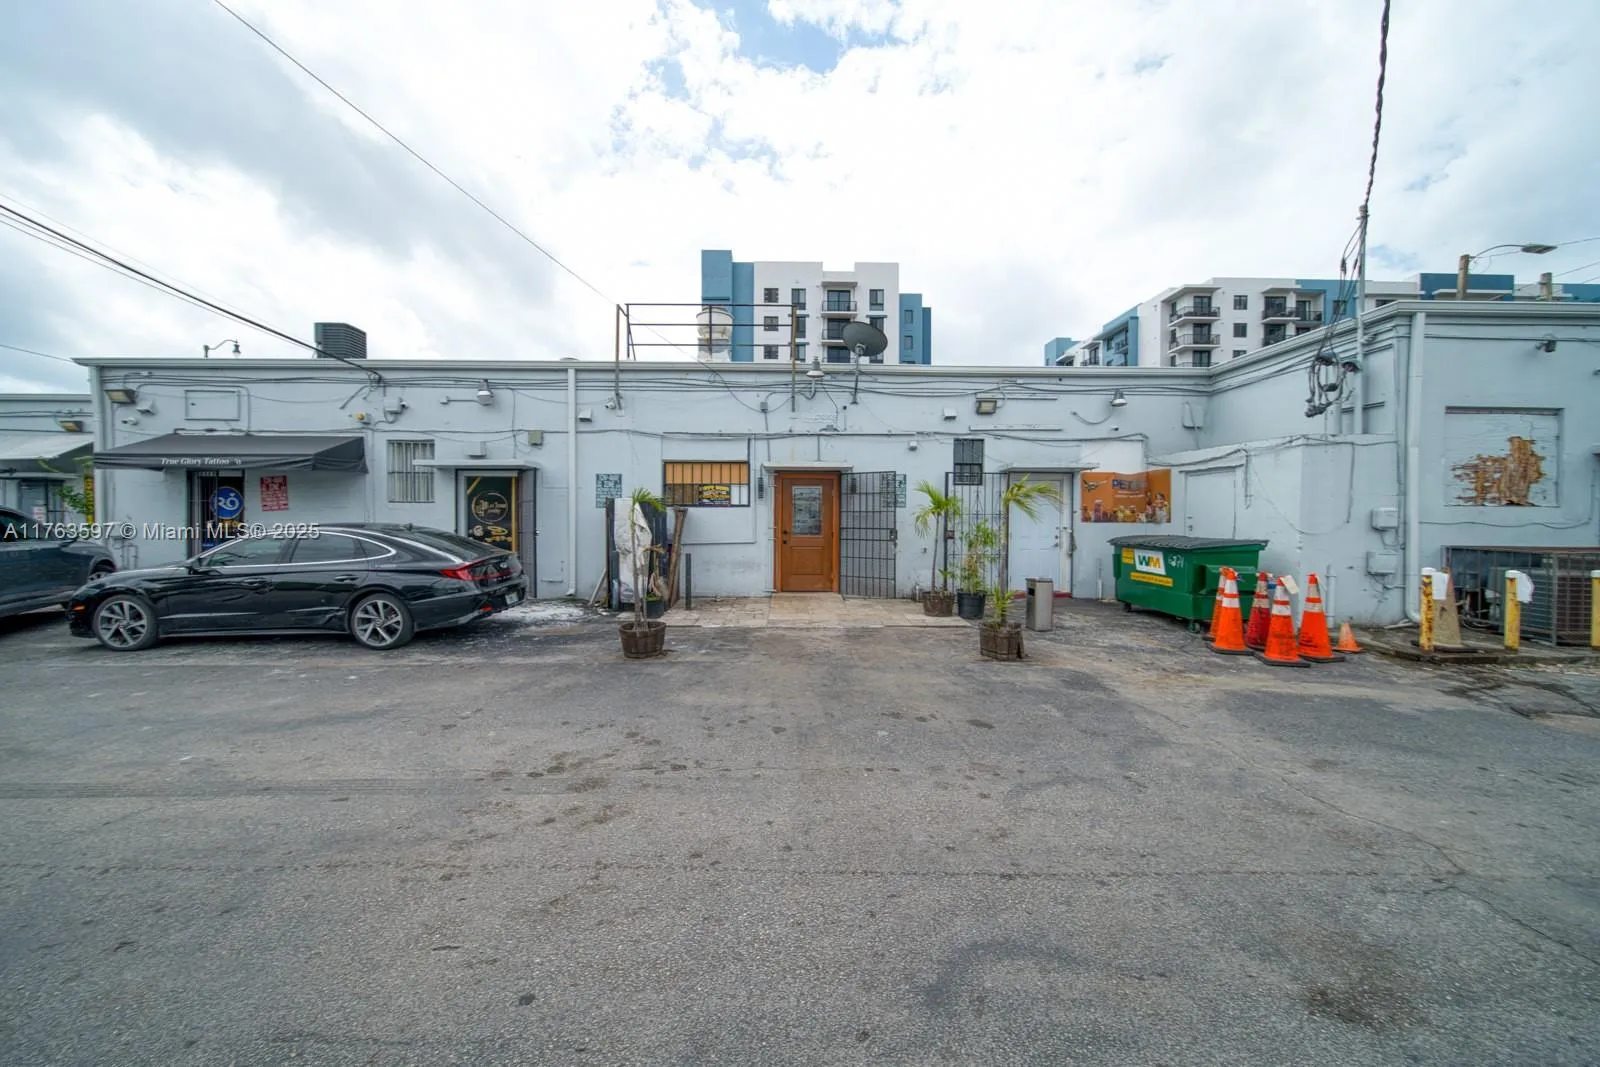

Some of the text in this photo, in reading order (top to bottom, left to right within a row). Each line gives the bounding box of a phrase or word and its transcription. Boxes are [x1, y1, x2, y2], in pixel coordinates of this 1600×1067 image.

[160, 457, 230, 466] True Glory Tattoo
[1138, 554, 1161, 569] WM
